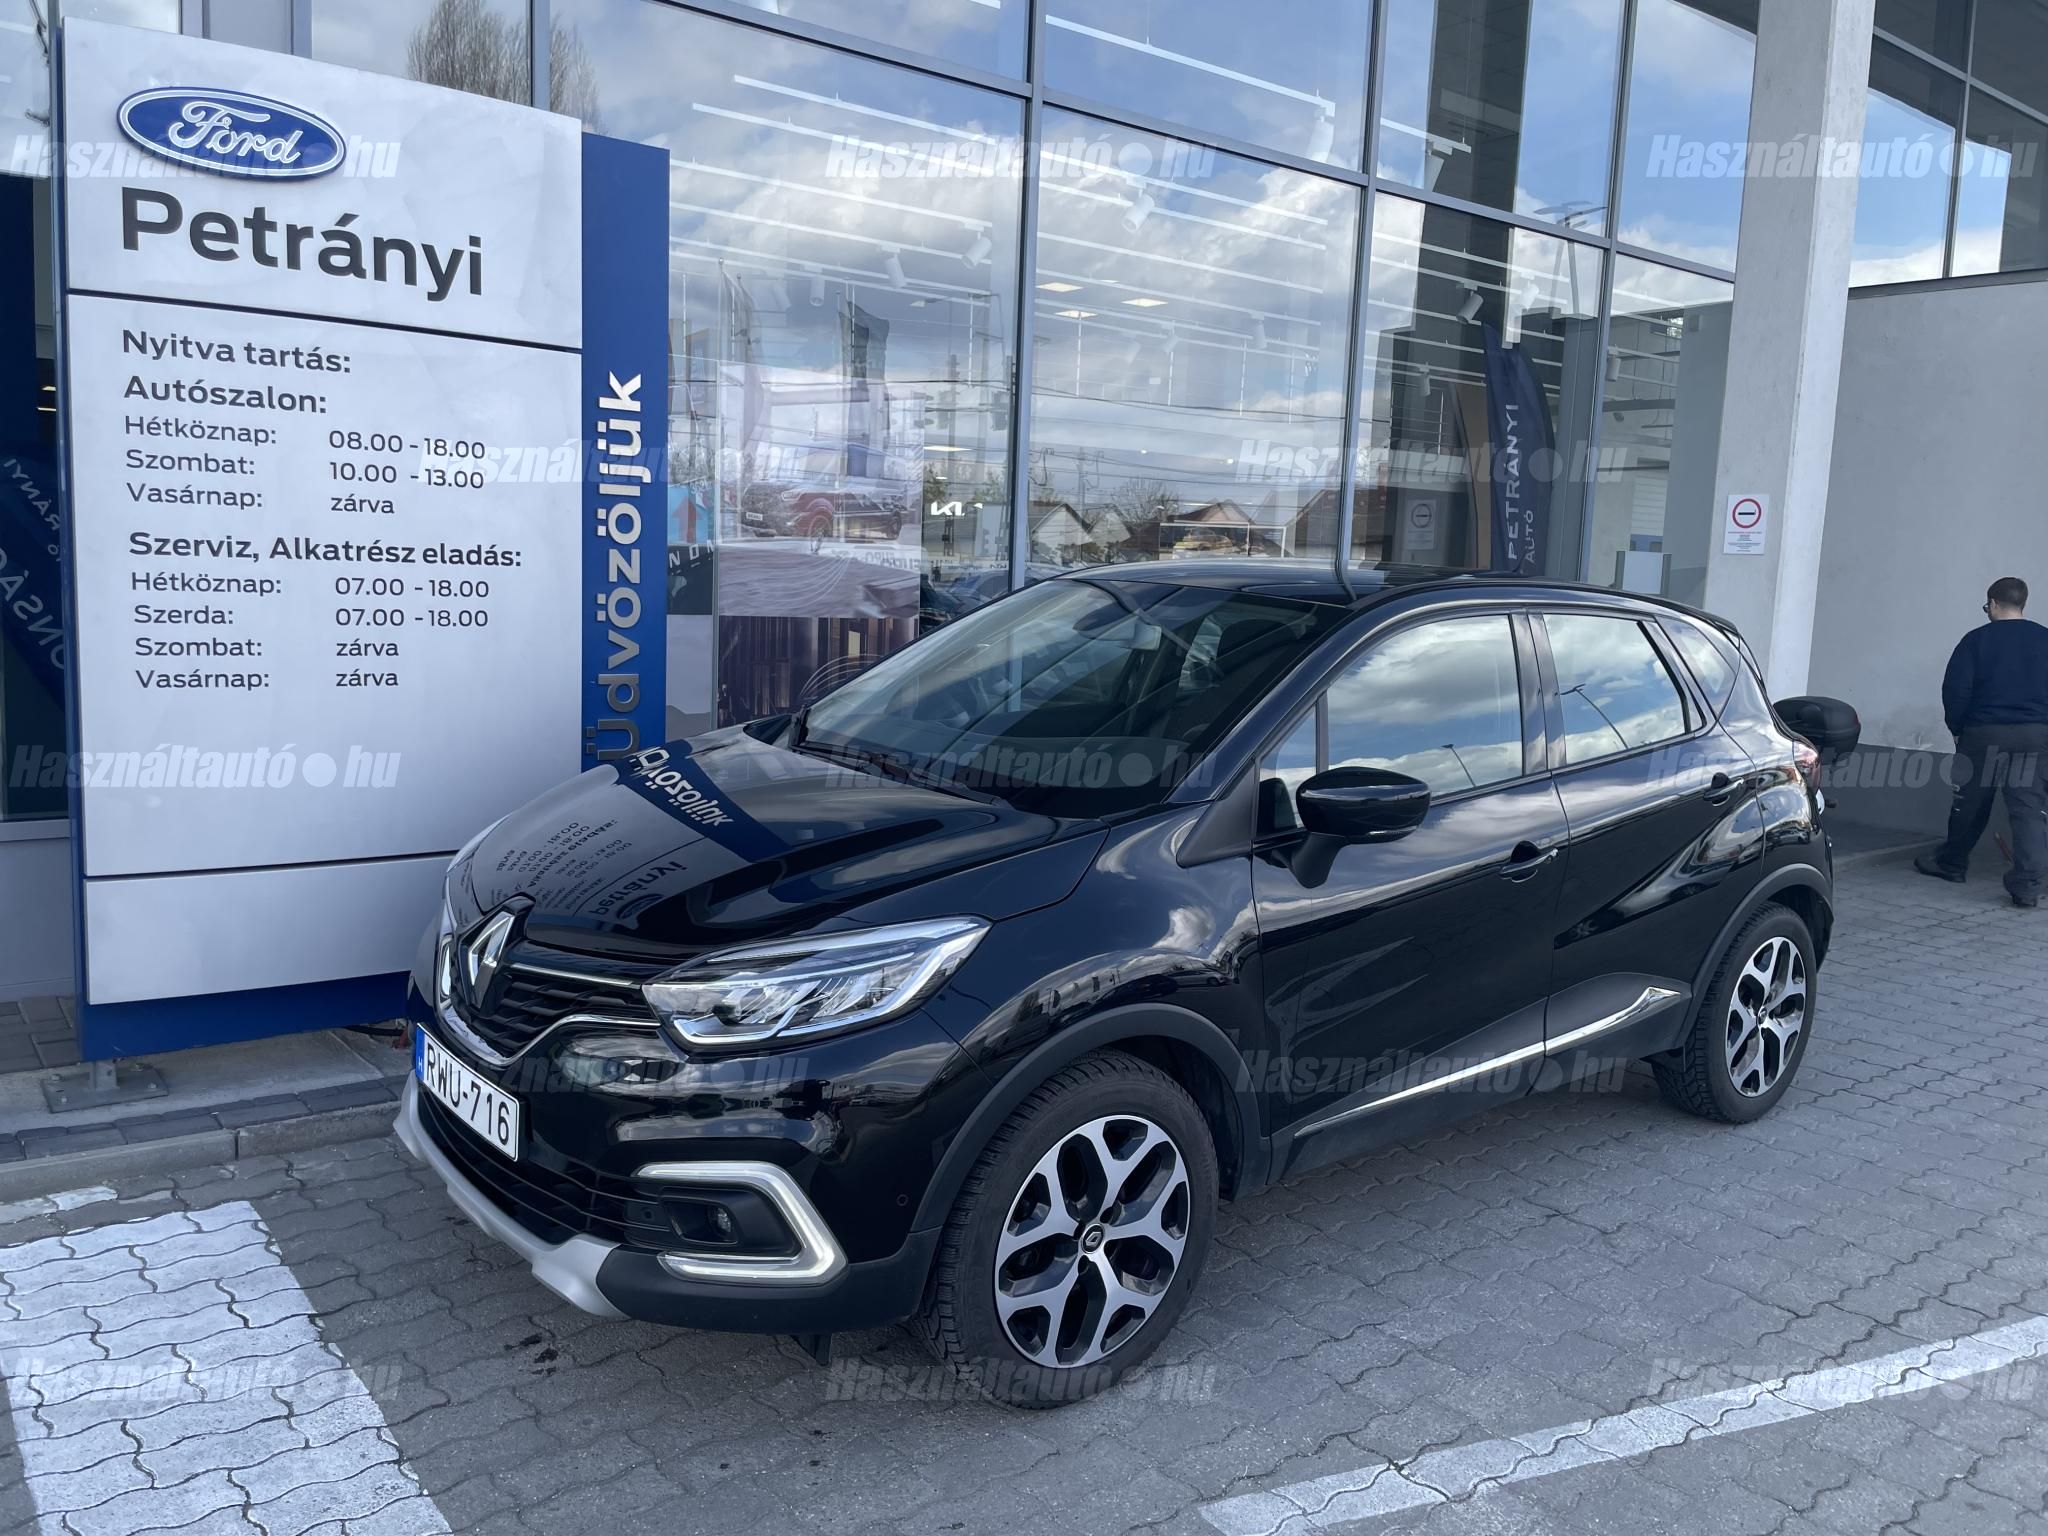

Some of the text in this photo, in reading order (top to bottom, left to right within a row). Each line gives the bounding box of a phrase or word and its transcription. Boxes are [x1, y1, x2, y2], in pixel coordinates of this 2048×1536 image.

[168, 101, 303, 164] Ford
[121, 187, 482, 301] Petrányi
[122, 329, 351, 374] Nyitva tartás:
[123, 375, 326, 414] Autószalon:
[125, 415, 277, 446] Hétköznap:
[329, 430, 403, 453] 08.00
[126, 449, 255, 475] Szombat:
[329, 461, 397, 484] 10.00
[1505, 404, 1520, 560] PETRÁNYI
[126, 482, 395, 514] Vasárnap: zárva
[129, 531, 522, 567] Szerviz, Alkatrész eladás:
[1523, 509, 1536, 564] AUTÓ
[131, 571, 282, 597] Hétköznap:
[335, 576, 405, 596] 07.00
[586, 371, 651, 762] Üdvözöljük
[134, 604, 234, 625] Szerda:
[335, 608, 405, 627] 07.00
[135, 637, 399, 657] Szombat: zárva
[135, 668, 399, 691] Vasárnap: zárva
[418, 1042, 510, 1146] H RWU-716
